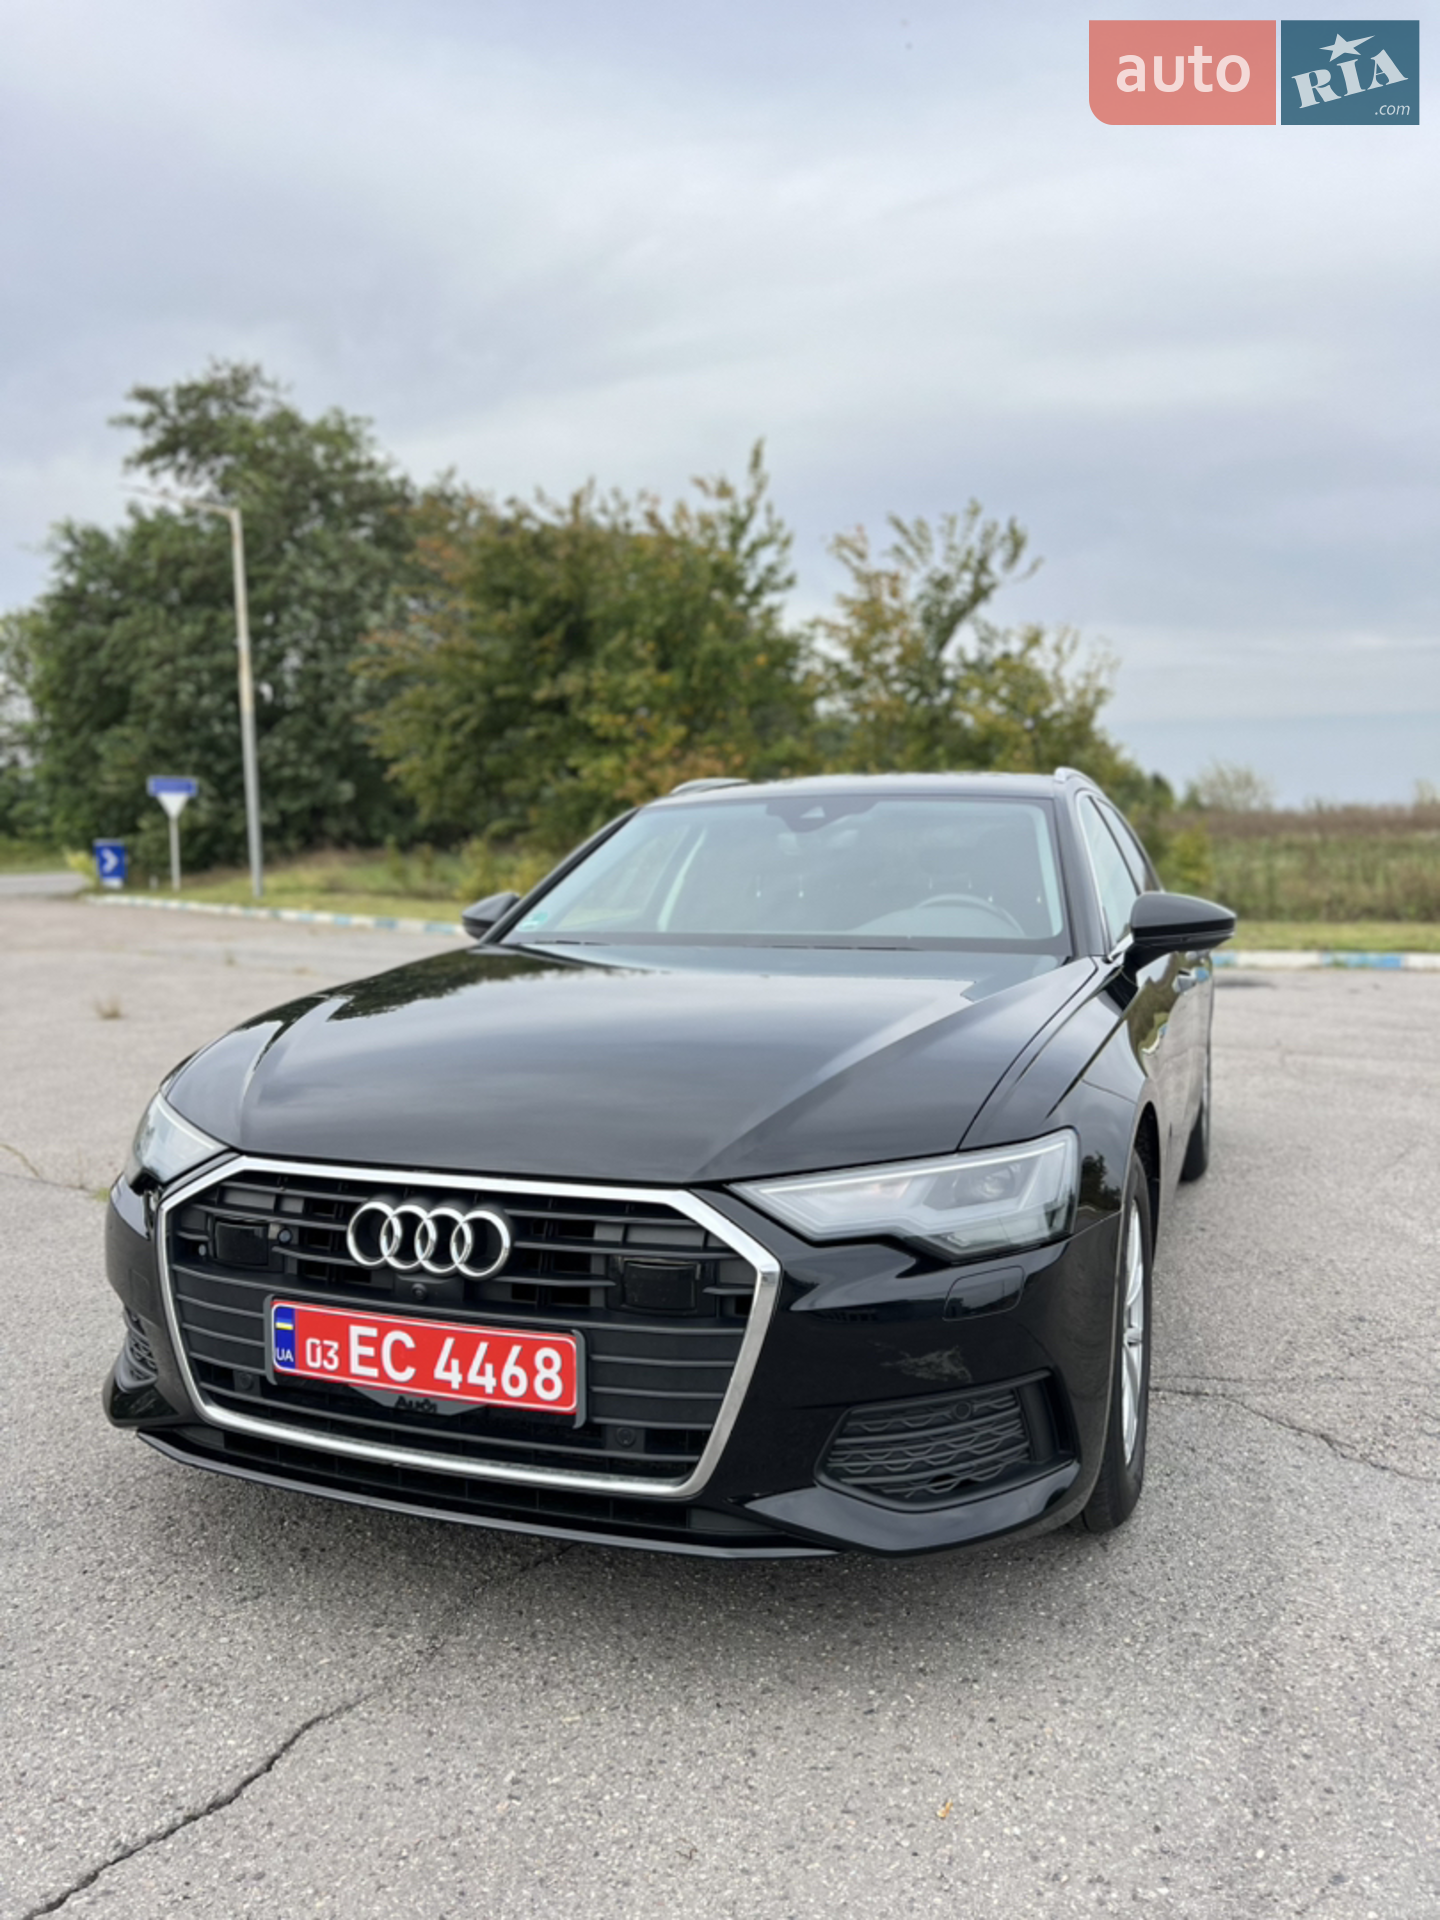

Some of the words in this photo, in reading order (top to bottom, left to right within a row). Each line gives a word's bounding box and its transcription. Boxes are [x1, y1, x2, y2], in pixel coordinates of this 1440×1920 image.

[275, 1347, 294, 1363] UA
[305, 1337, 339, 1371] 03
[349, 1325, 416, 1383] EC
[433, 1337, 563, 1401] 4468
